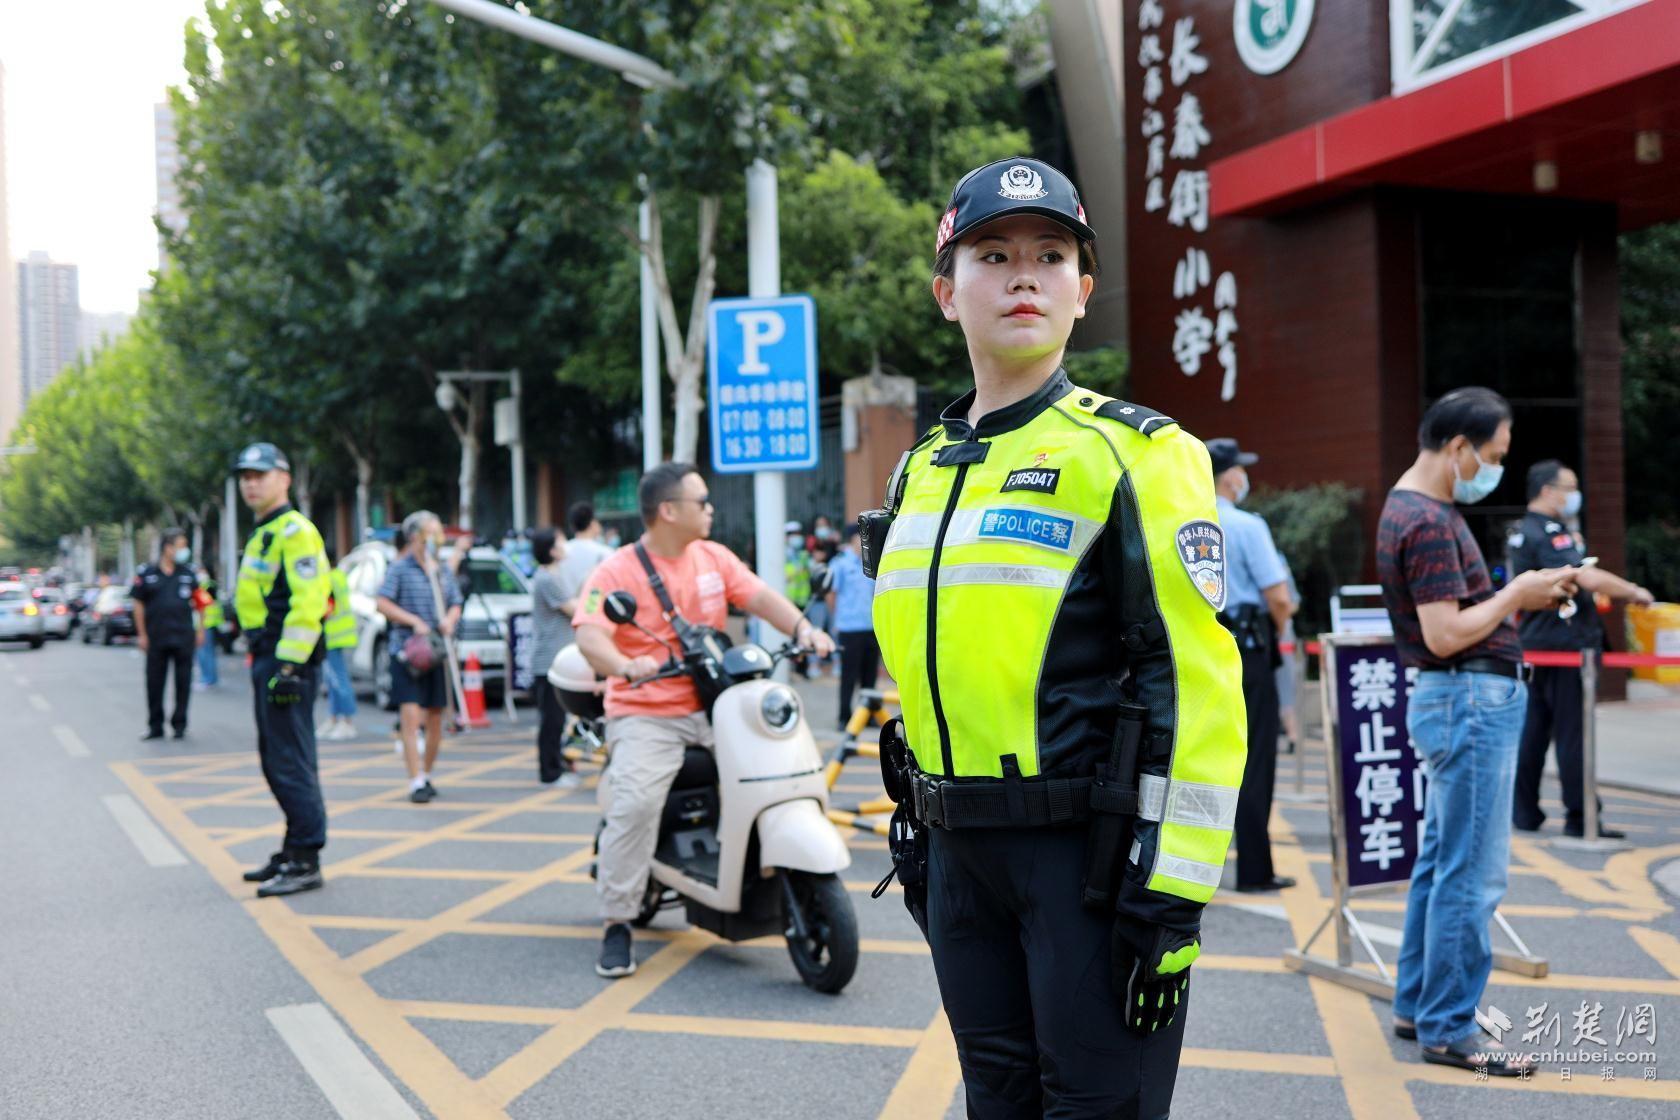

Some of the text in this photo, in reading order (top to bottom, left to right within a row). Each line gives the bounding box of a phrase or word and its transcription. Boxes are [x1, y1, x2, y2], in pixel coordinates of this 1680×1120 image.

[1168, 16, 1213, 377] 长春街小学
[735, 310, 786, 376] P
[1006, 471, 1056, 487] FJ05047
[1350, 657, 1405, 871] 禁止停车
